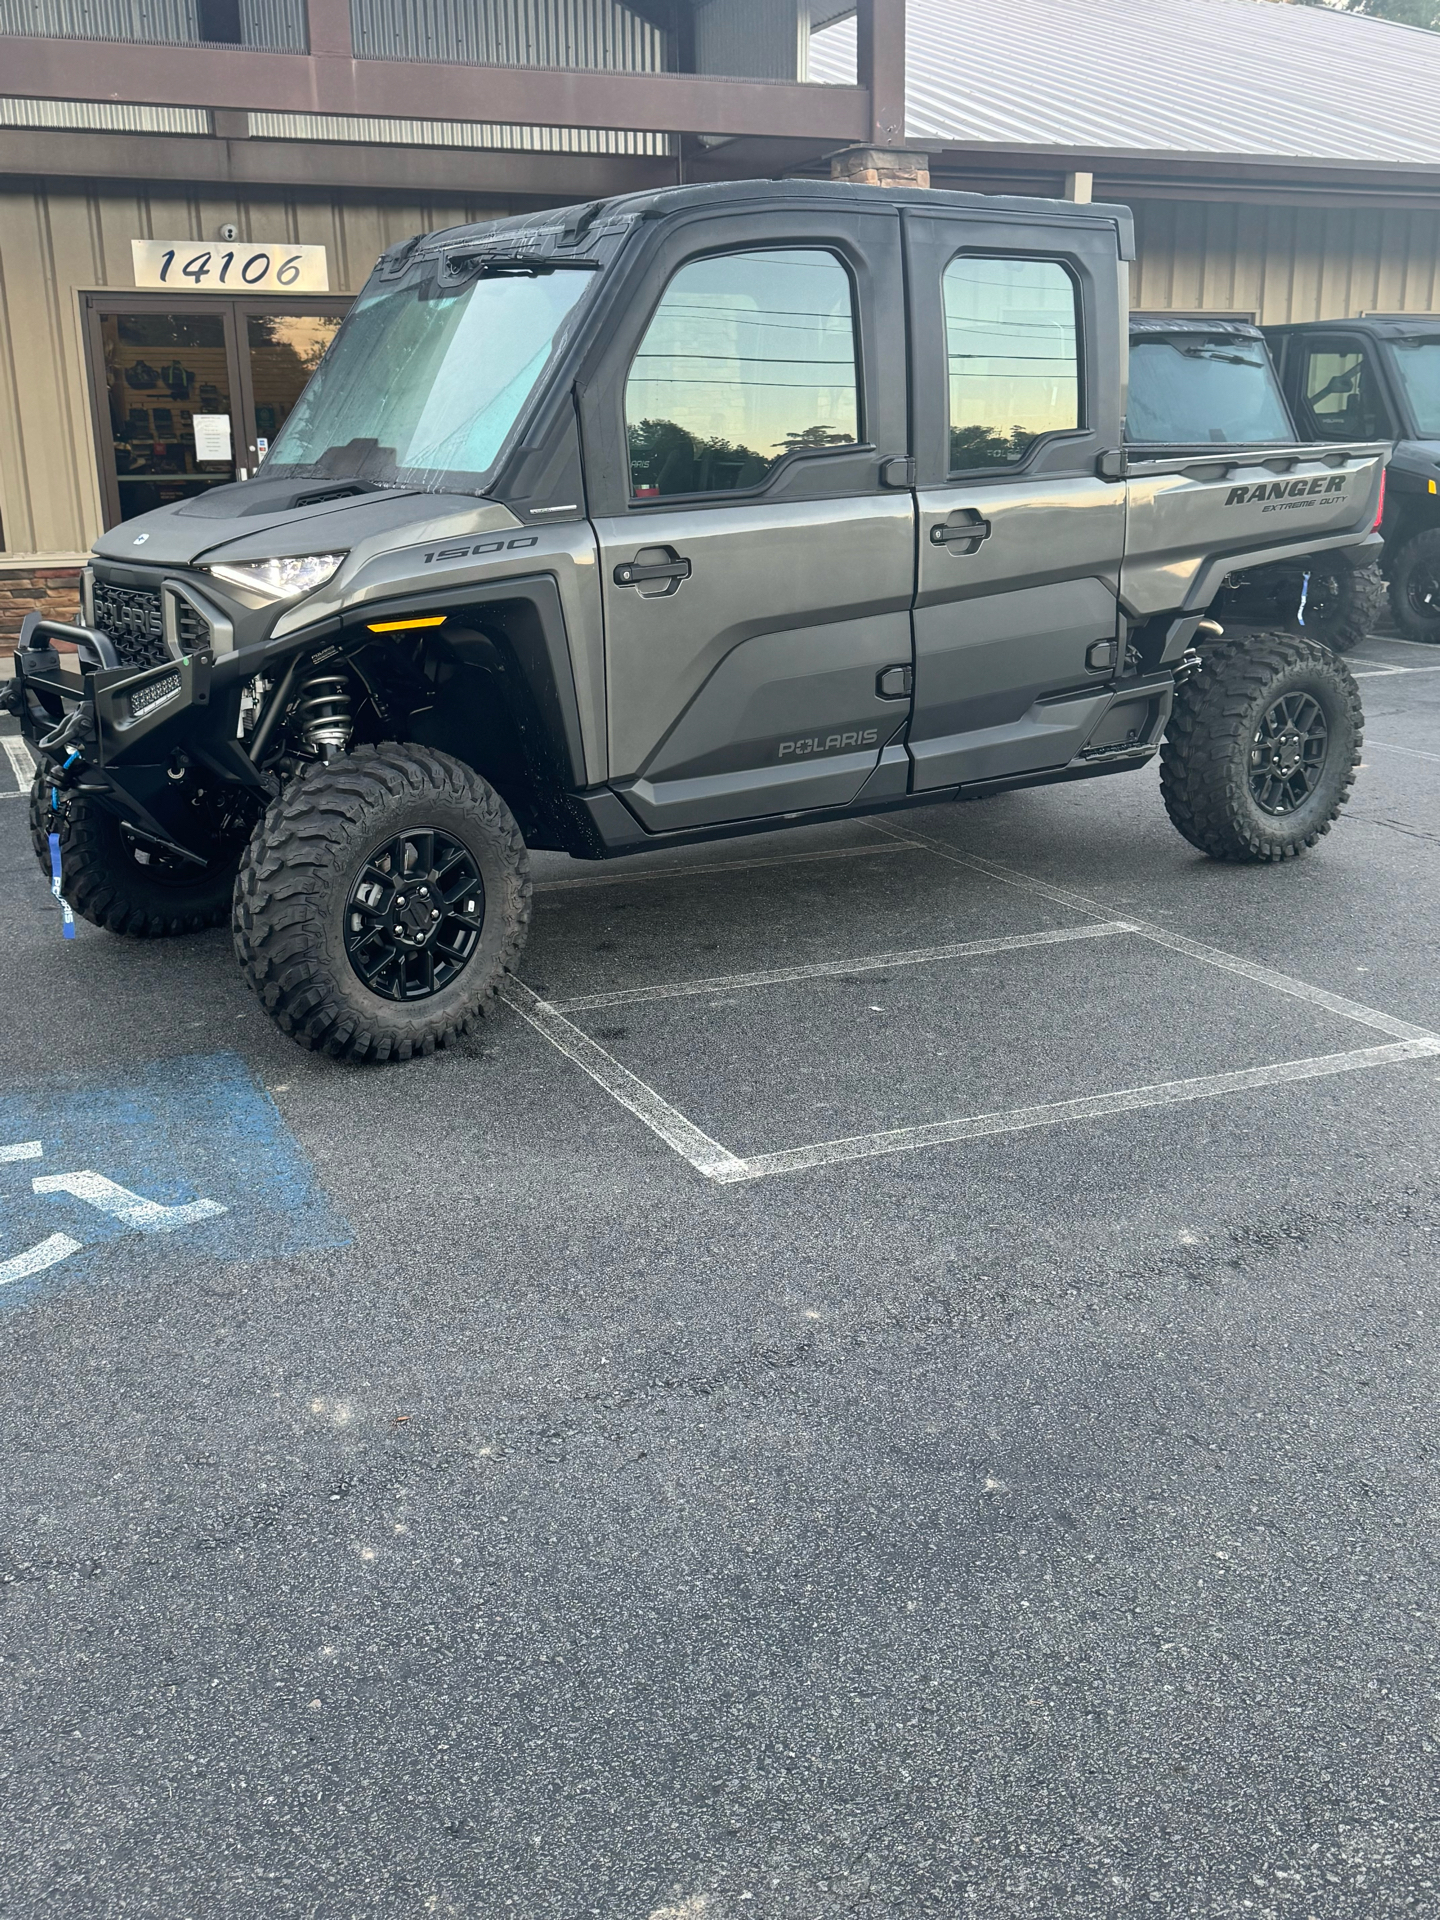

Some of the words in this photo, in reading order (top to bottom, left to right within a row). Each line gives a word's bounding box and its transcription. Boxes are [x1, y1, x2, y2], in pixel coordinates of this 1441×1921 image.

[159, 249, 303, 286] 14106
[1224, 475, 1347, 506] RANGER
[1262, 499, 1317, 513] EXTREME
[1319, 495, 1348, 505] DUTY
[424, 536, 539, 564] 1500
[94, 599, 163, 636] POLARIS
[778, 728, 878, 758] POLARIS
